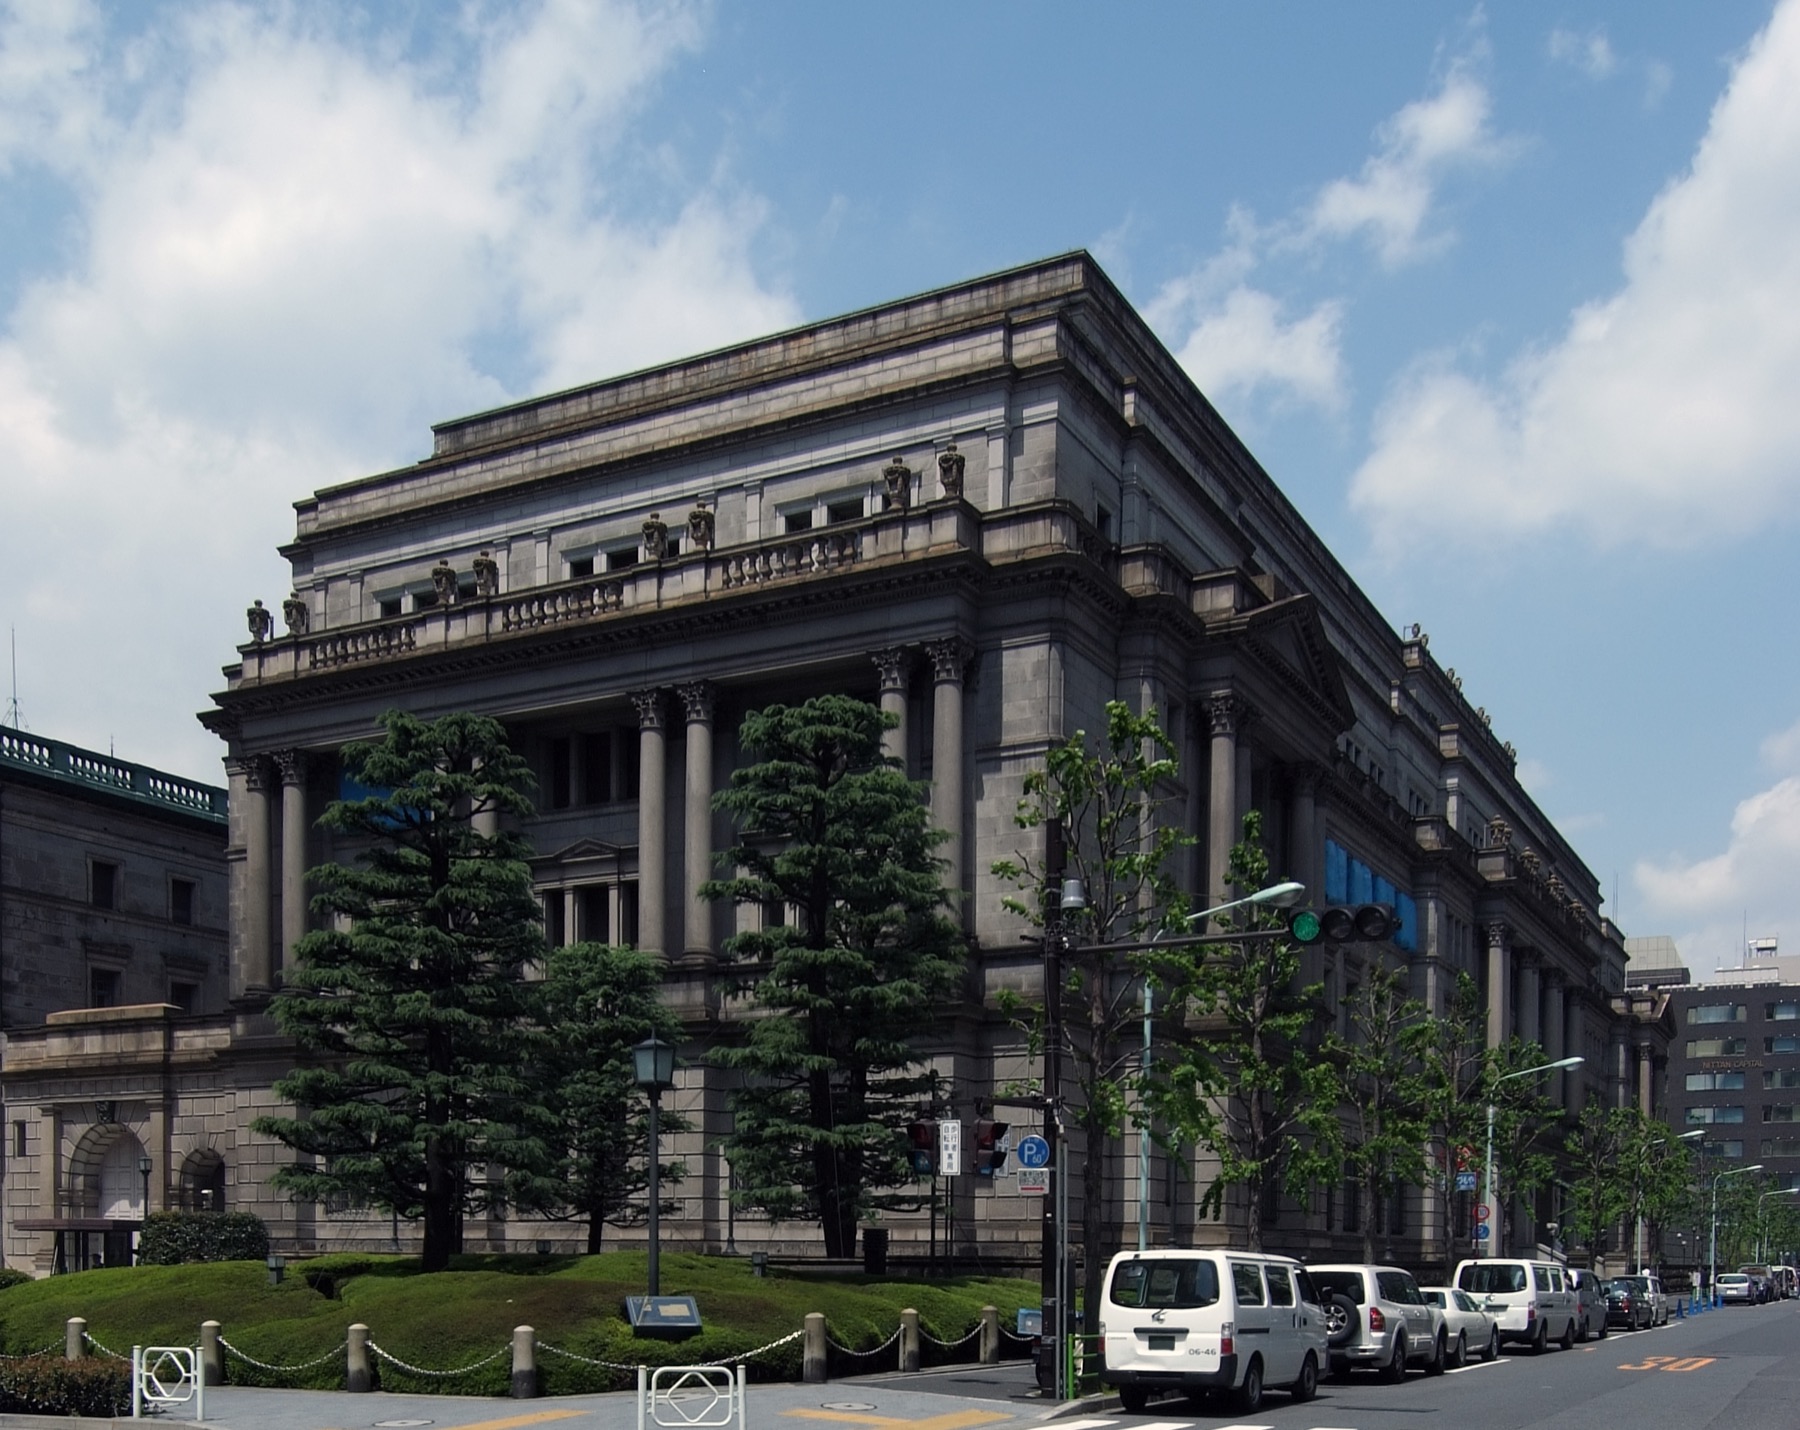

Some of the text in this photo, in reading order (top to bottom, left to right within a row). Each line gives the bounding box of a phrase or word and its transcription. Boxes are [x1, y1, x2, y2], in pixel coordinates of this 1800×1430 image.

[1024, 1143, 1037, 1164] P
[1188, 1348, 1216, 1356] 06-46
[1616, 1355, 1717, 1371] 30
